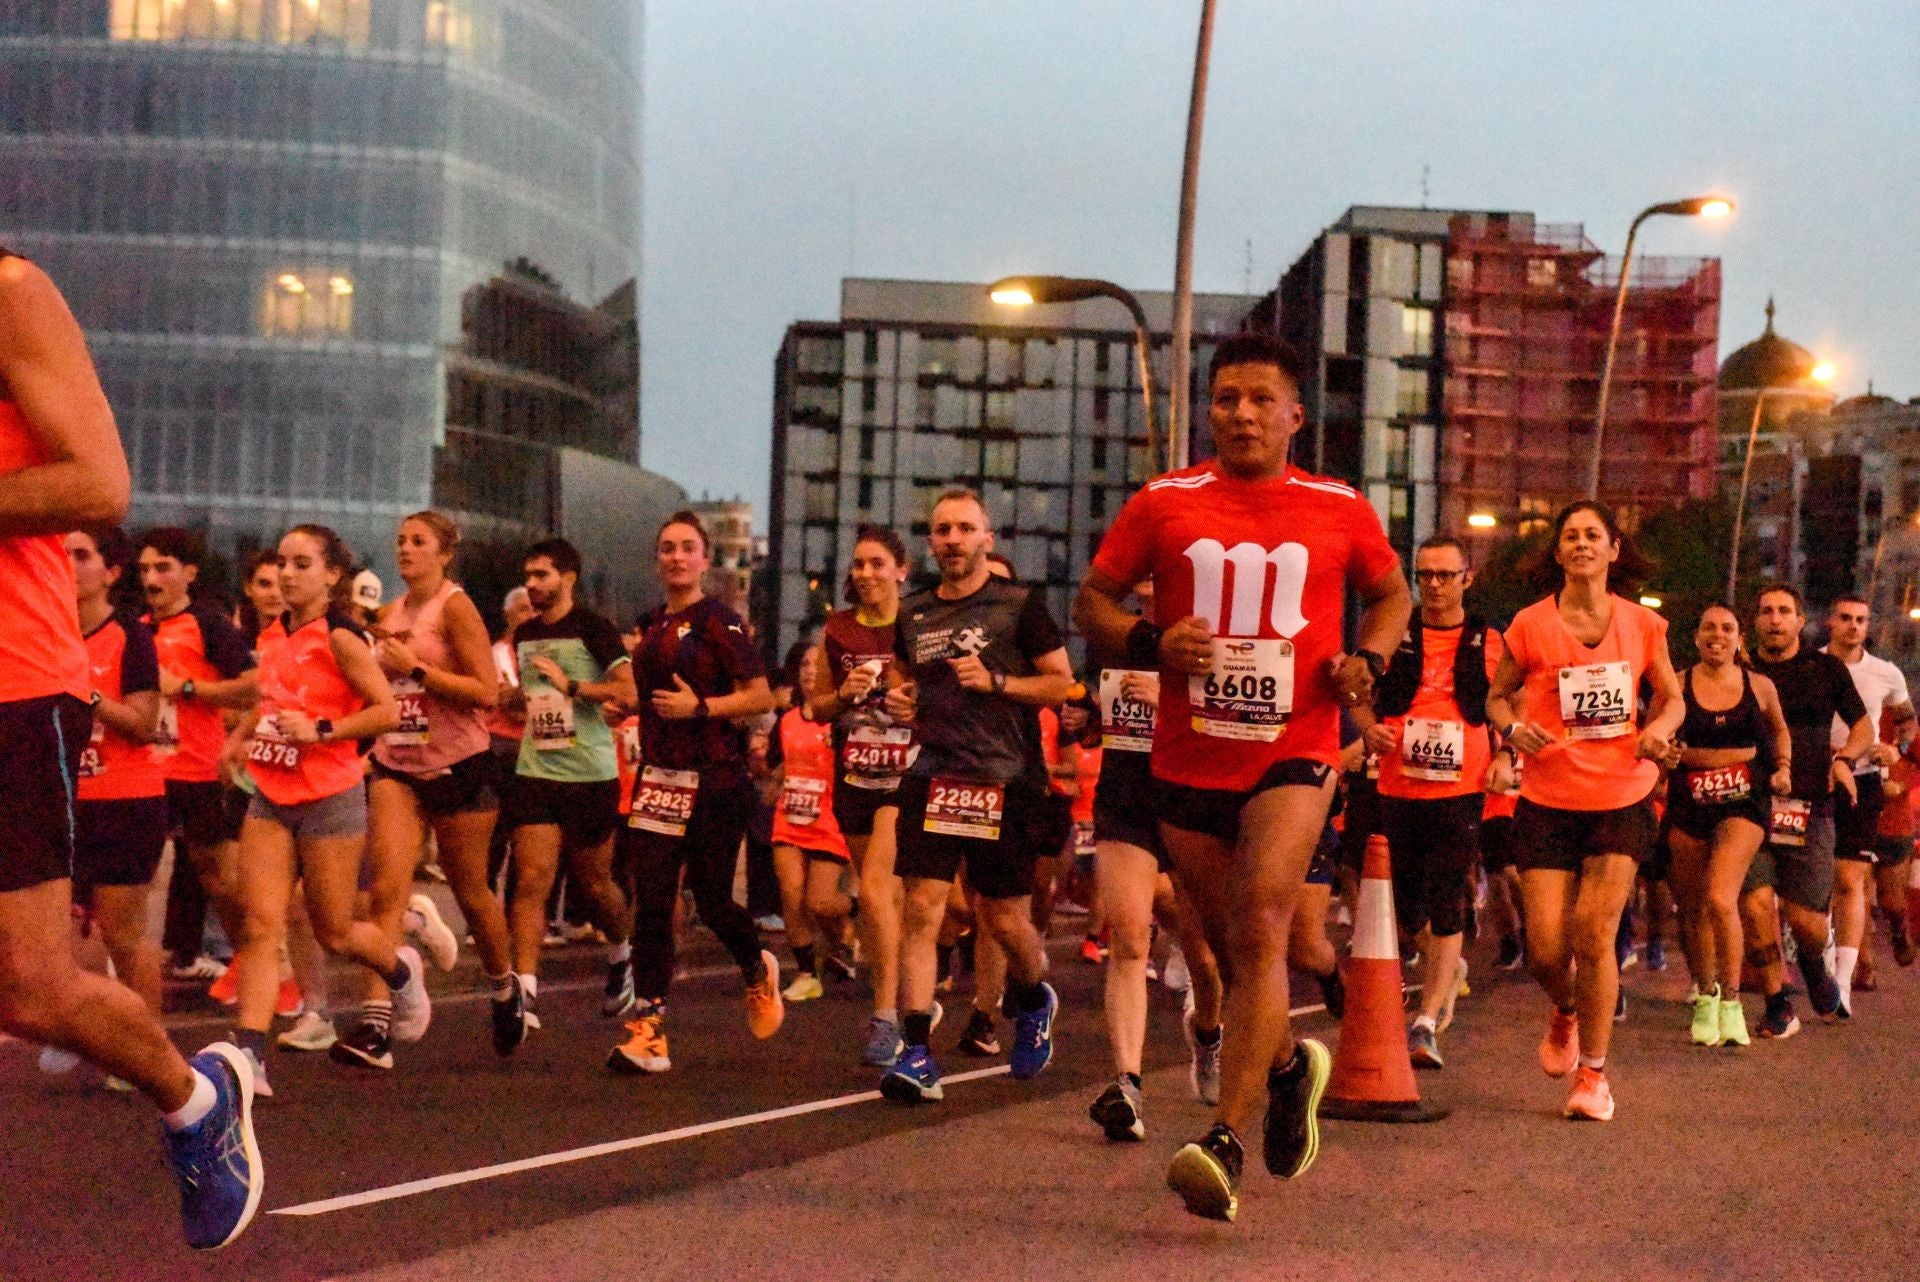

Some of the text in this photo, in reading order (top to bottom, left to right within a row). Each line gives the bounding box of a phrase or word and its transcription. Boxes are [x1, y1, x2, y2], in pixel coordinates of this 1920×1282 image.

[1222, 664, 1257, 672] GUAMAN
[1203, 672, 1277, 701] 6608
[1572, 688, 1624, 711] 7234
[847, 748, 902, 766] 24011
[1411, 739, 1455, 757] 6664
[1693, 769, 1746, 792] 26214
[638, 787, 692, 810] 23825
[932, 787, 999, 811] 22849
